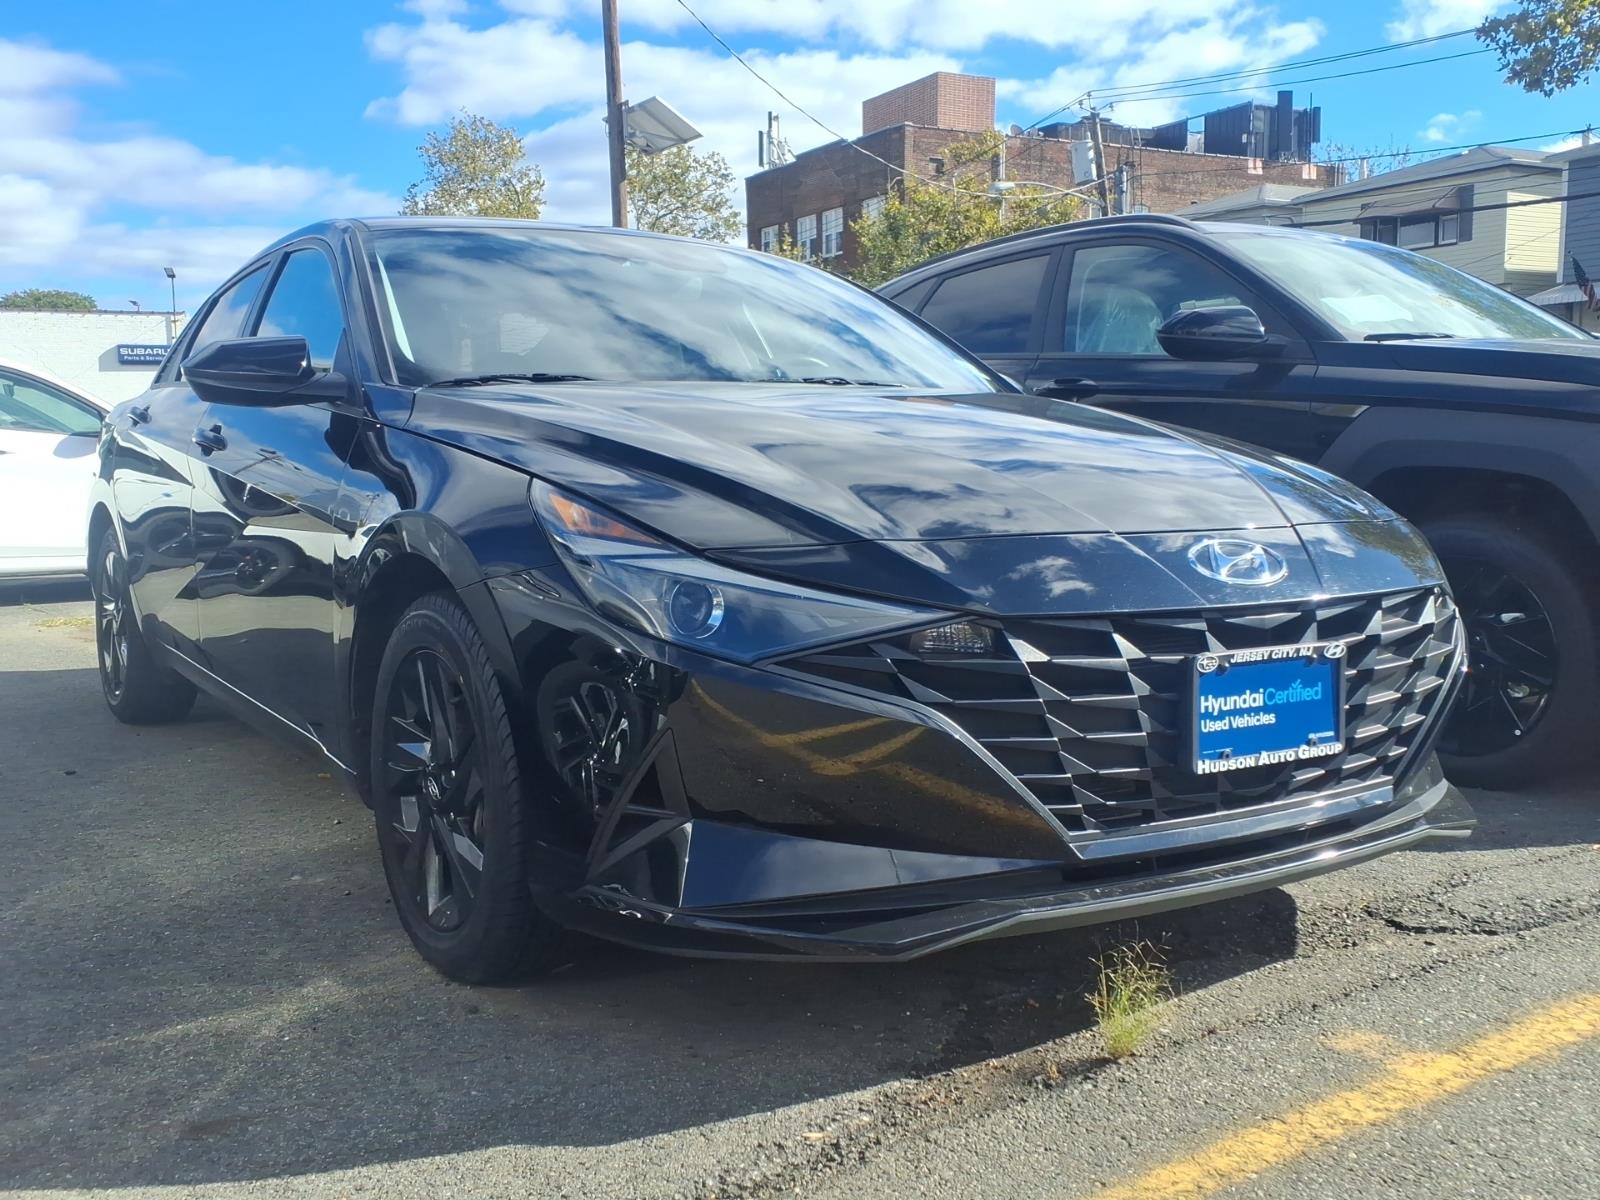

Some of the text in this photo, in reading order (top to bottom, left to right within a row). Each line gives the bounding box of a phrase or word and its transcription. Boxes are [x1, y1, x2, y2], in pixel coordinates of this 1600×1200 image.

[1230, 651, 1271, 663] JERSEY
[1299, 646, 1313, 657] NJ
[1200, 681, 1322, 716] Hyundai Certified
[1201, 711, 1276, 733] Used Vehicles
[1197, 743, 1344, 775] HUDSON AUTO GROUP
